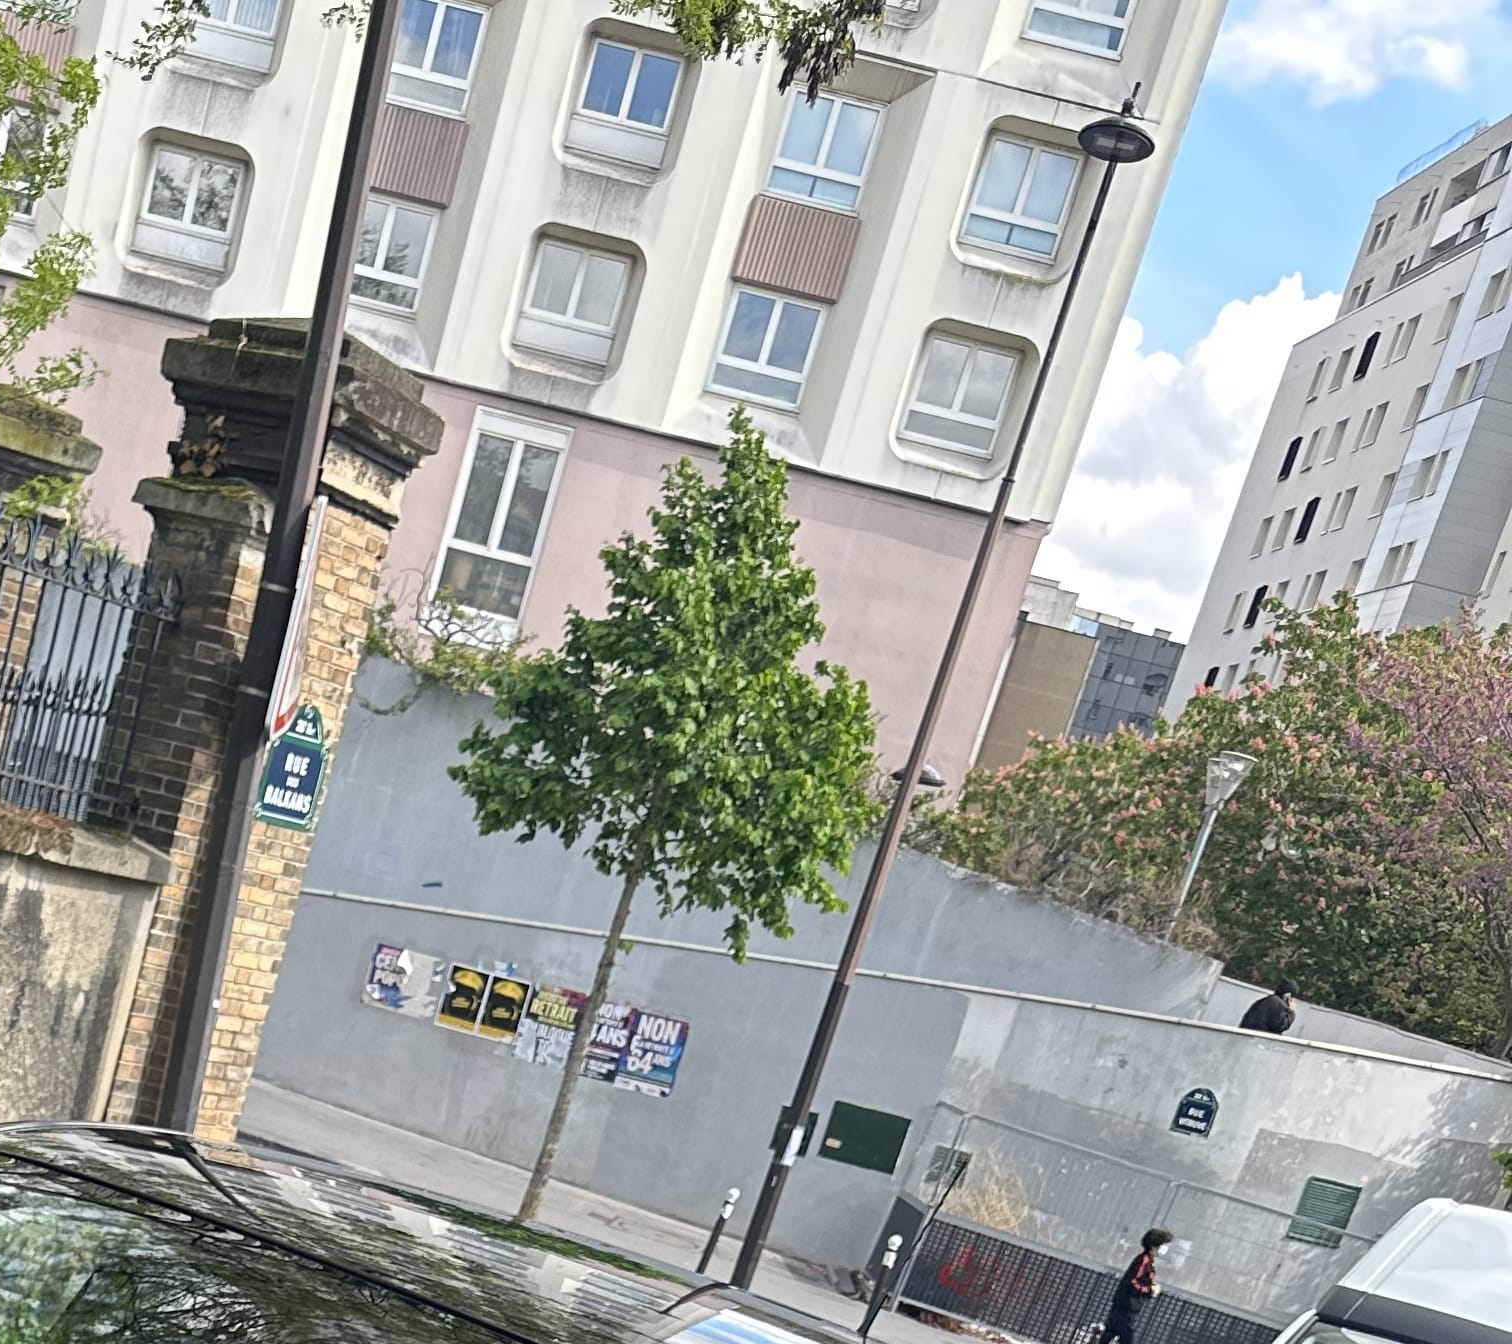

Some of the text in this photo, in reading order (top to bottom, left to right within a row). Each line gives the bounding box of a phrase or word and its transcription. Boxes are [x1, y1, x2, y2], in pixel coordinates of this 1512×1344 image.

[284, 753, 311, 776] RUE
[263, 785, 312, 813] BALKANS
[637, 1014, 682, 1045] NON
